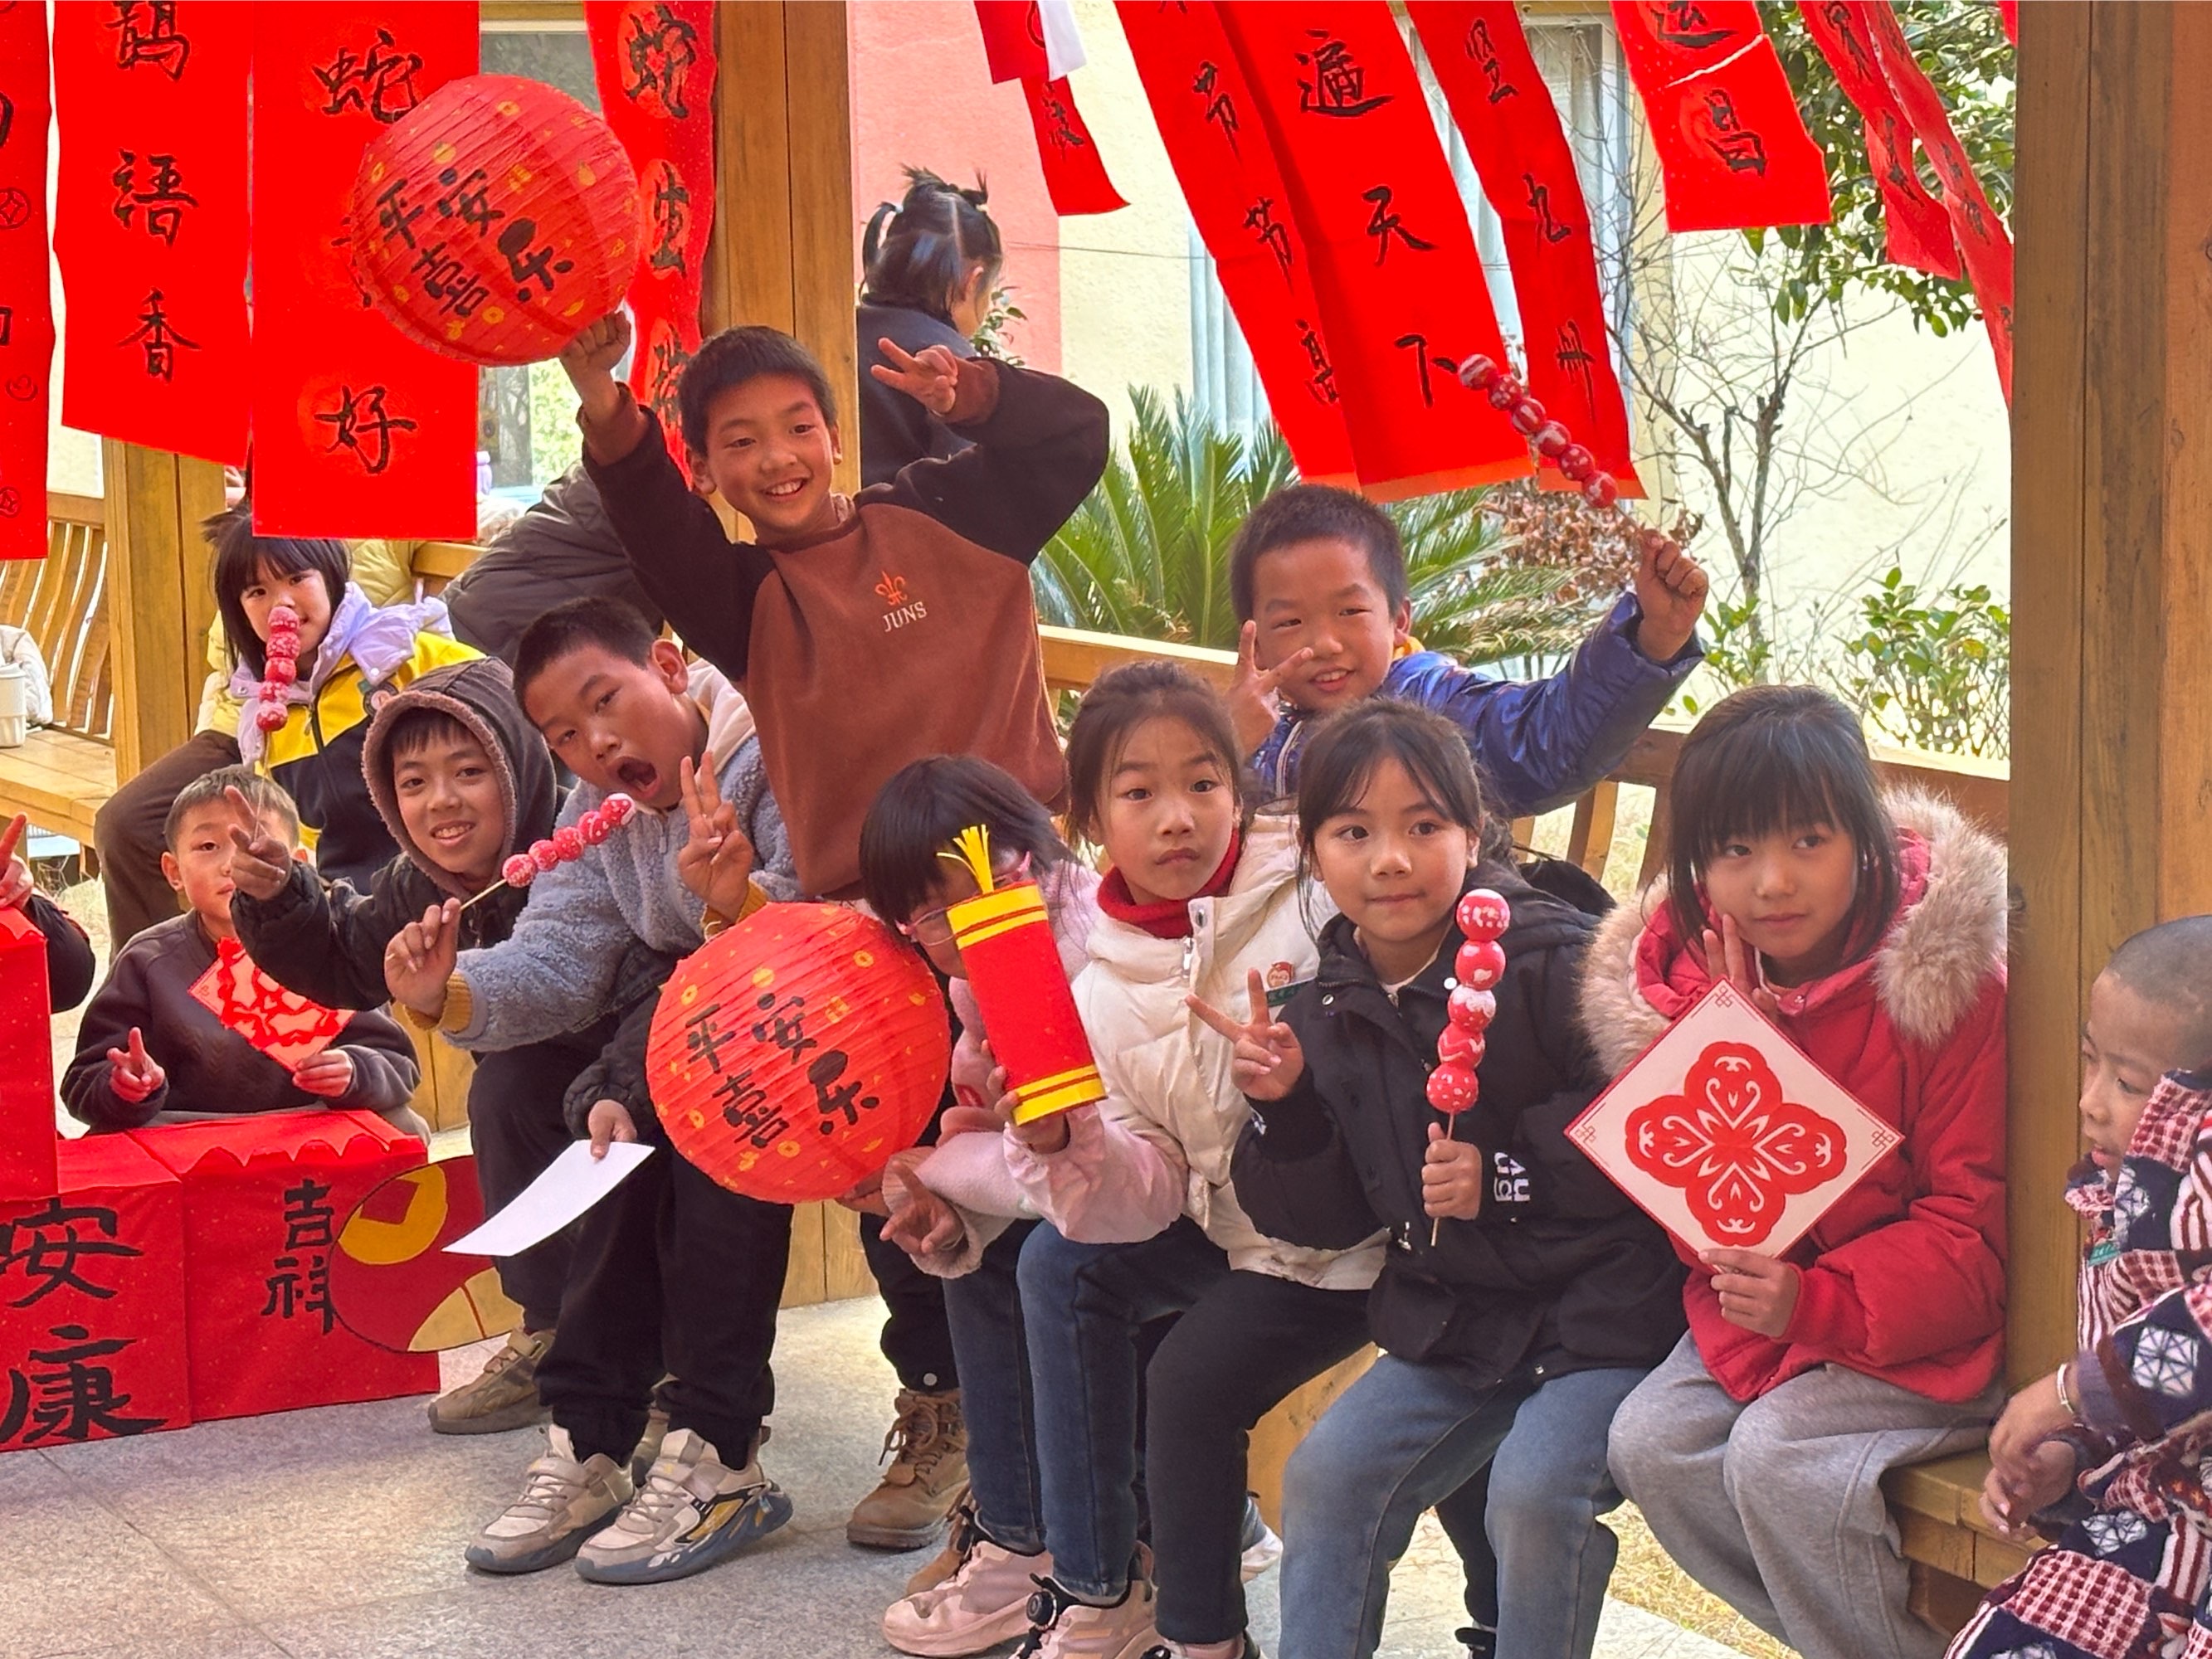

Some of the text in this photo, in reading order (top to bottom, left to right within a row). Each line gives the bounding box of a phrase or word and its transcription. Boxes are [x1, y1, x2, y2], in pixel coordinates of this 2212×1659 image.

[375, 168, 505, 249] 平安
[411, 217, 575, 318] 喜乐
[882, 601, 928, 633] JUNS
[685, 993, 817, 1074] 平安
[712, 1049, 880, 1148] 喜乐
[0, 1197, 169, 1444] 安康
